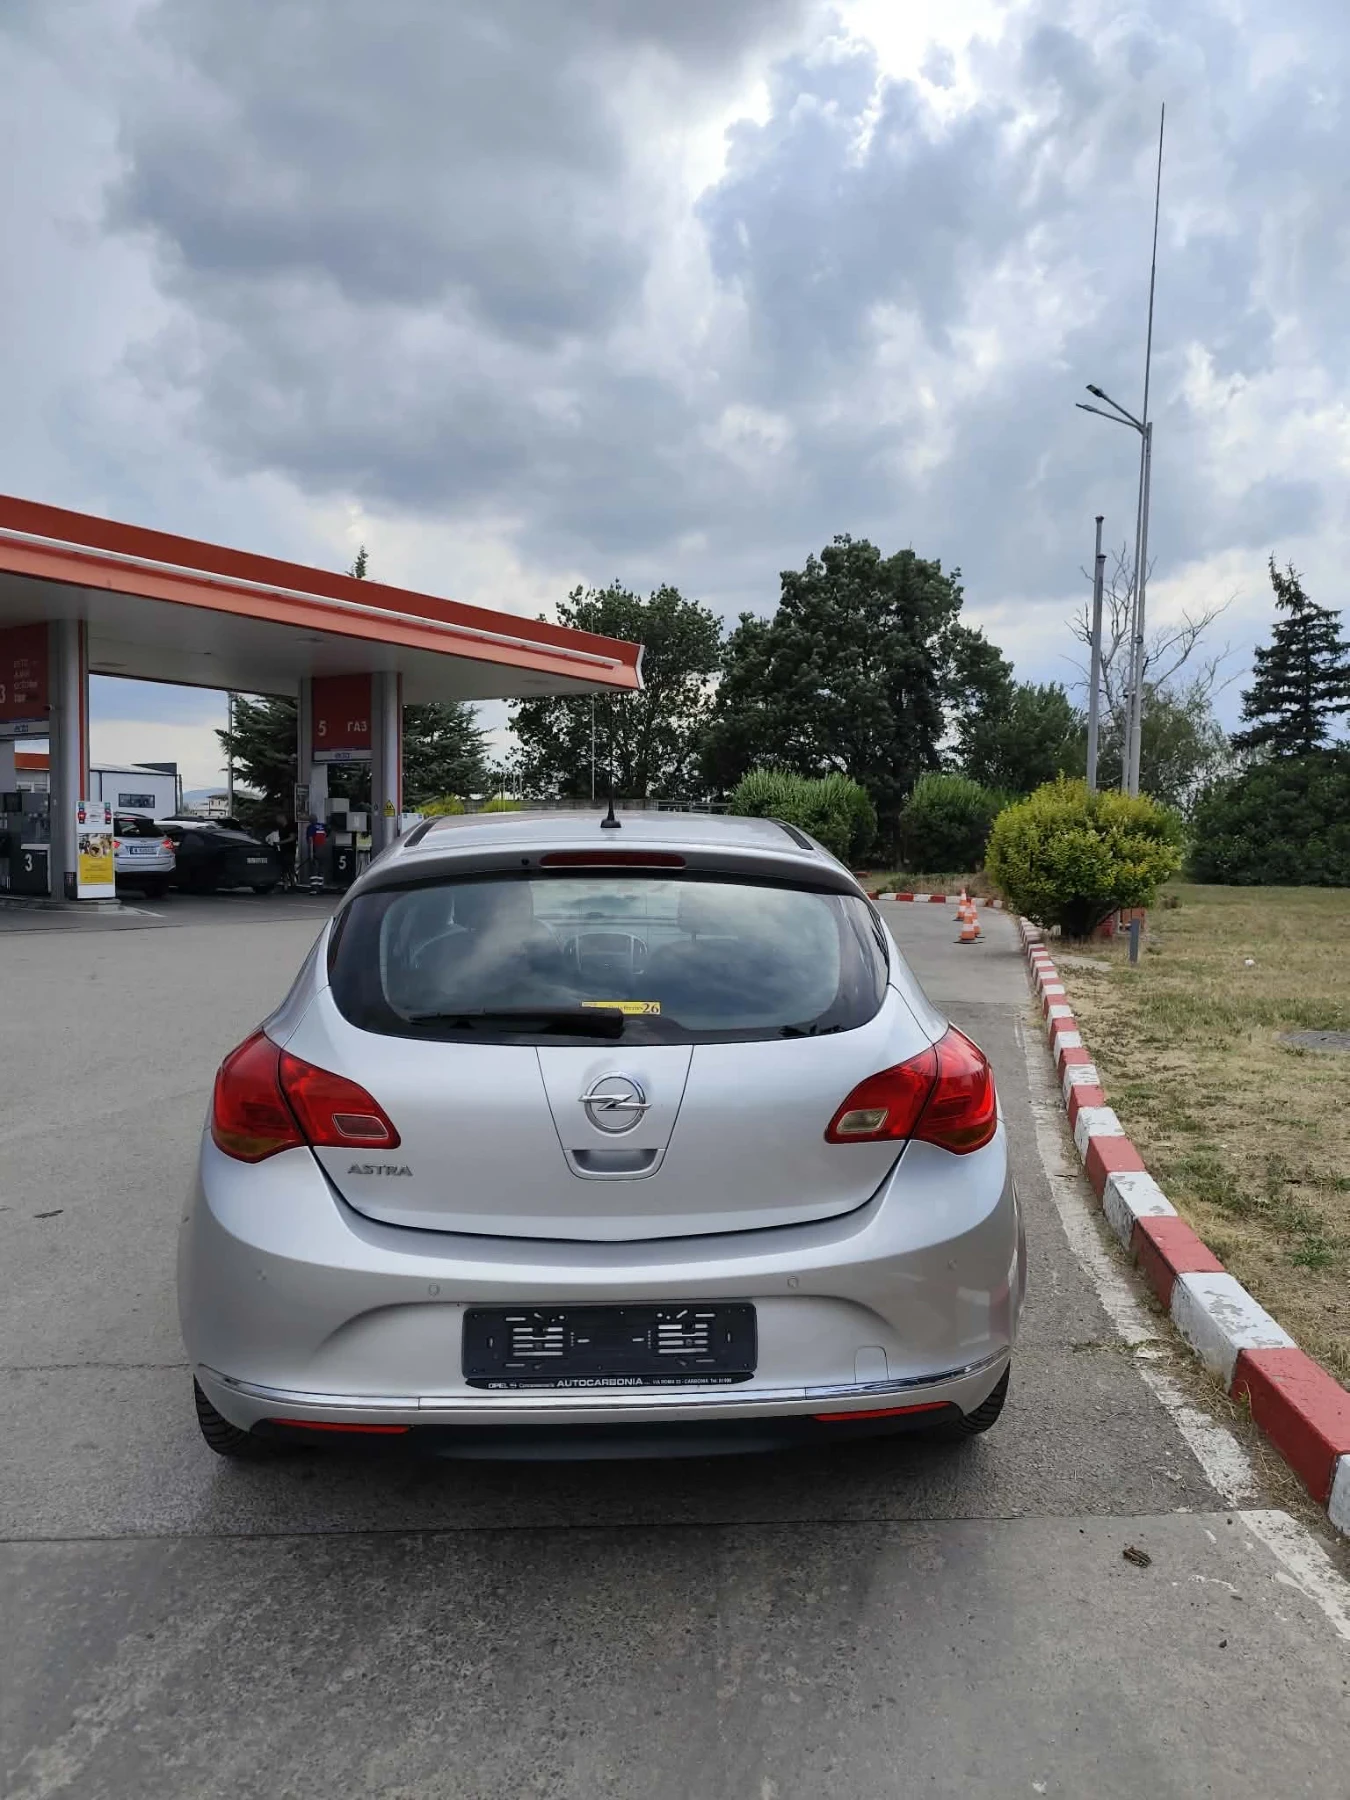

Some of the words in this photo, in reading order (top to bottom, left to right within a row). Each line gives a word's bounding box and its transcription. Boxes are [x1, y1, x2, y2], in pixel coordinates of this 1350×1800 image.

[317, 719, 328, 737] 5
[347, 720, 368, 732] ГАЗ
[24, 853, 33, 872] 3
[338, 855, 347, 870] 5
[642, 1003, 659, 1013] 26
[347, 1163, 413, 1177] ASTRA
[556, 1378, 643, 1387] AUTOCARBONIA
